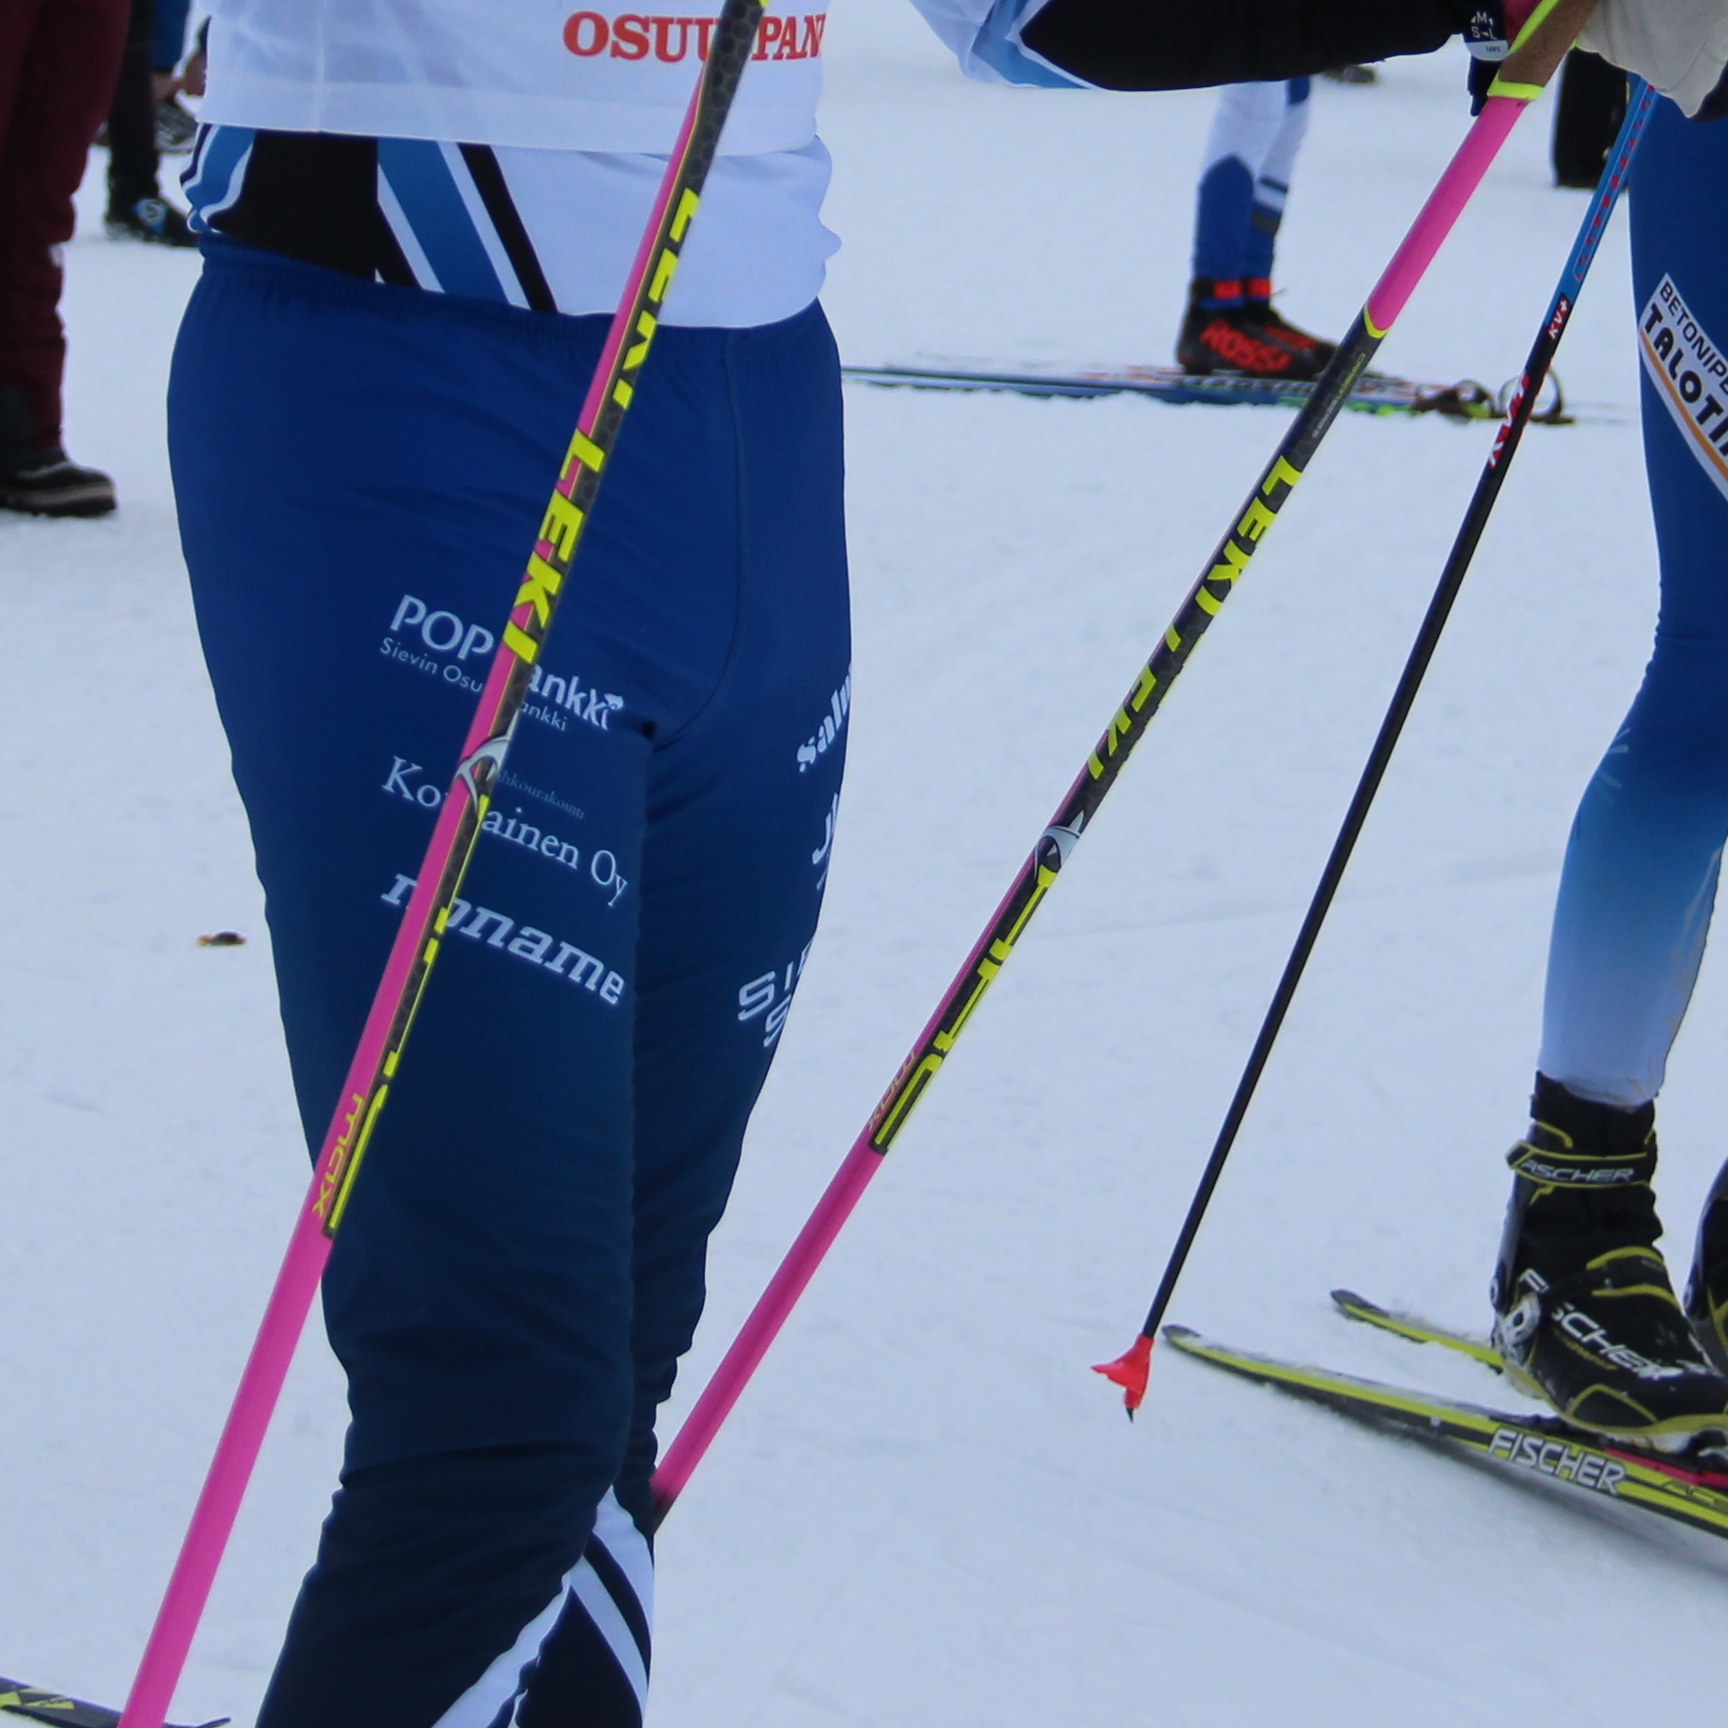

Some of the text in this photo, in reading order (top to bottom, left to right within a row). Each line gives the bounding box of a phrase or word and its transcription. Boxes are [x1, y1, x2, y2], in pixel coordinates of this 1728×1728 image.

[562, 11, 827, 64] OSUUPAN
[1547, 297, 1570, 340] KV+
[502, 428, 607, 664] LEKI
[1194, 454, 1303, 617] LEKI
[379, 636, 568, 732] Sievin Osuankki
[389, 594, 623, 732] POP ankki
[589, 849, 629, 908] Oy
[1487, 1423, 1629, 1496] FISCHER
